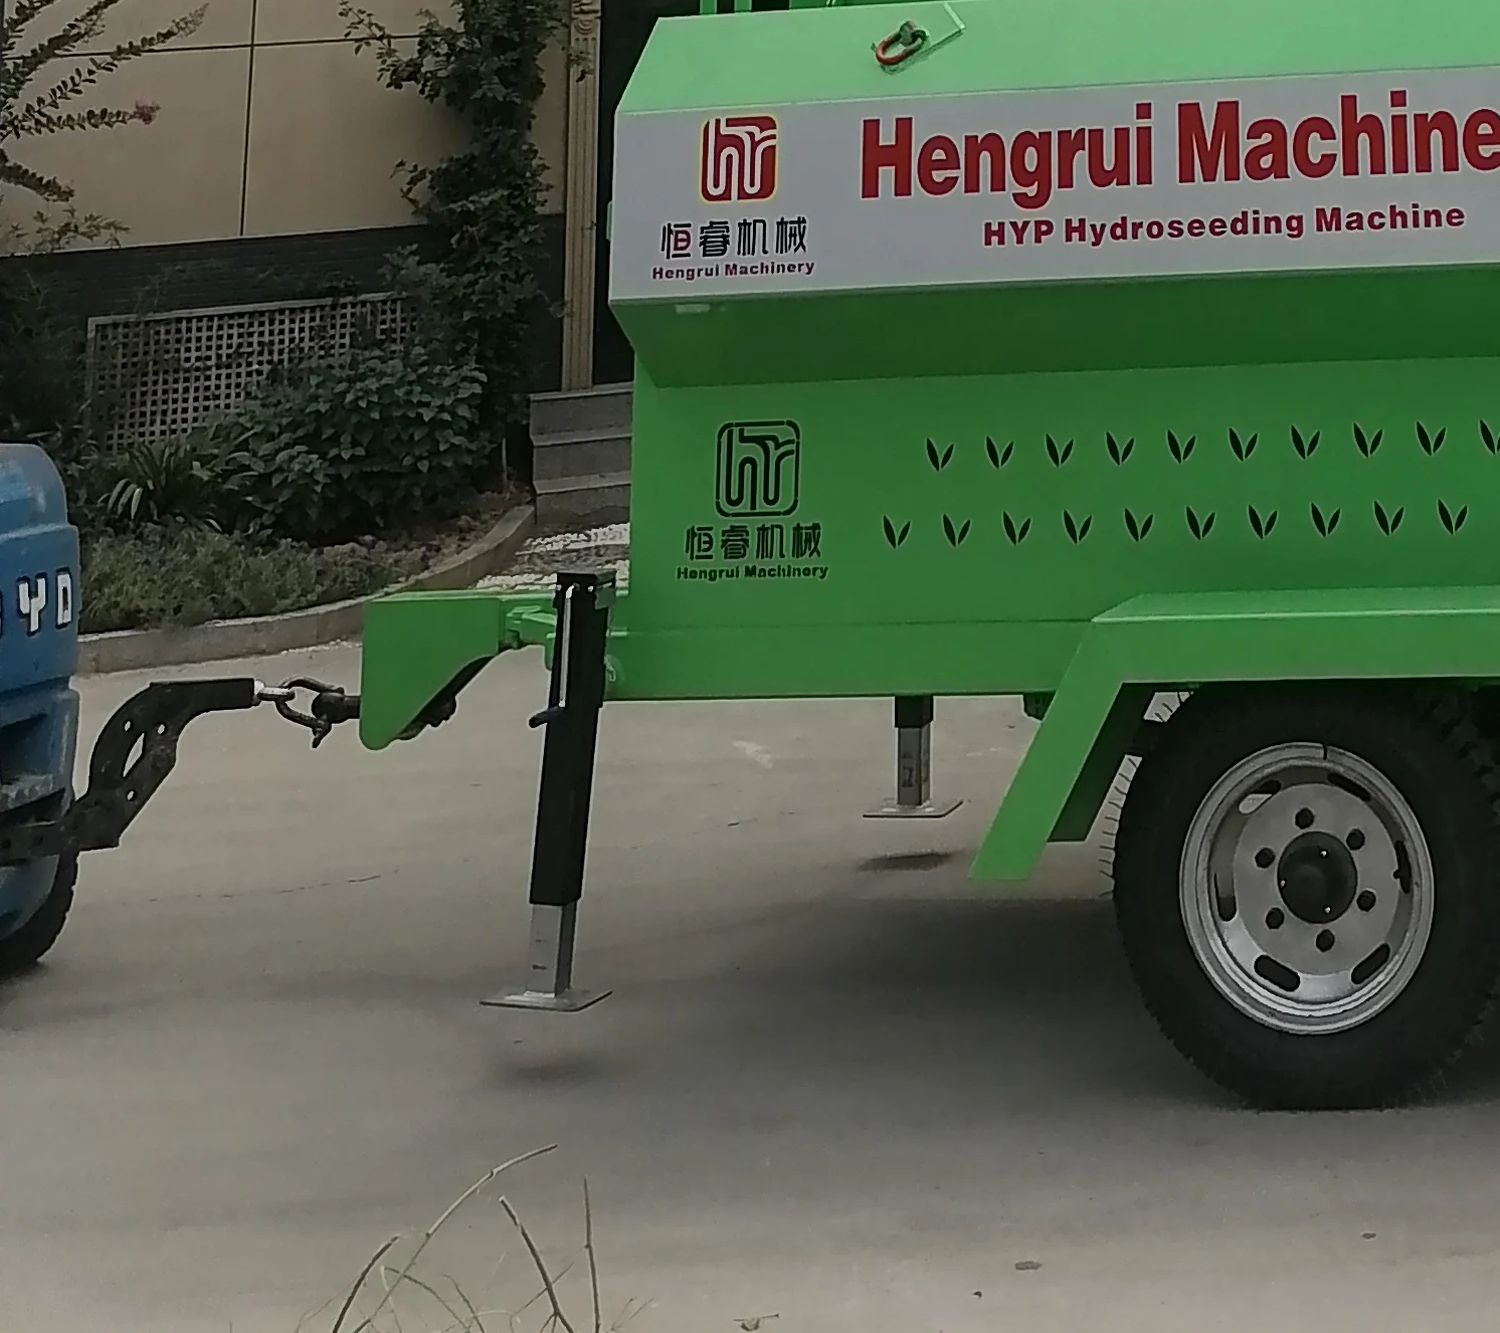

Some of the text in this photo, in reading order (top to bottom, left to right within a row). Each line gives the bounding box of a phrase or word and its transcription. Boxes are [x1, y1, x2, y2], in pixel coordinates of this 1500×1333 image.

[861, 102, 1153, 210] Hengrui
[661, 216, 807, 260] 恒睿机械
[984, 203, 1465, 247] HYP Hydroseeding Machine
[652, 261, 815, 281] Hengrui Machinery
[685, 522, 822, 561] 恒睿机械
[677, 564, 829, 581] Hengrui Machinery
